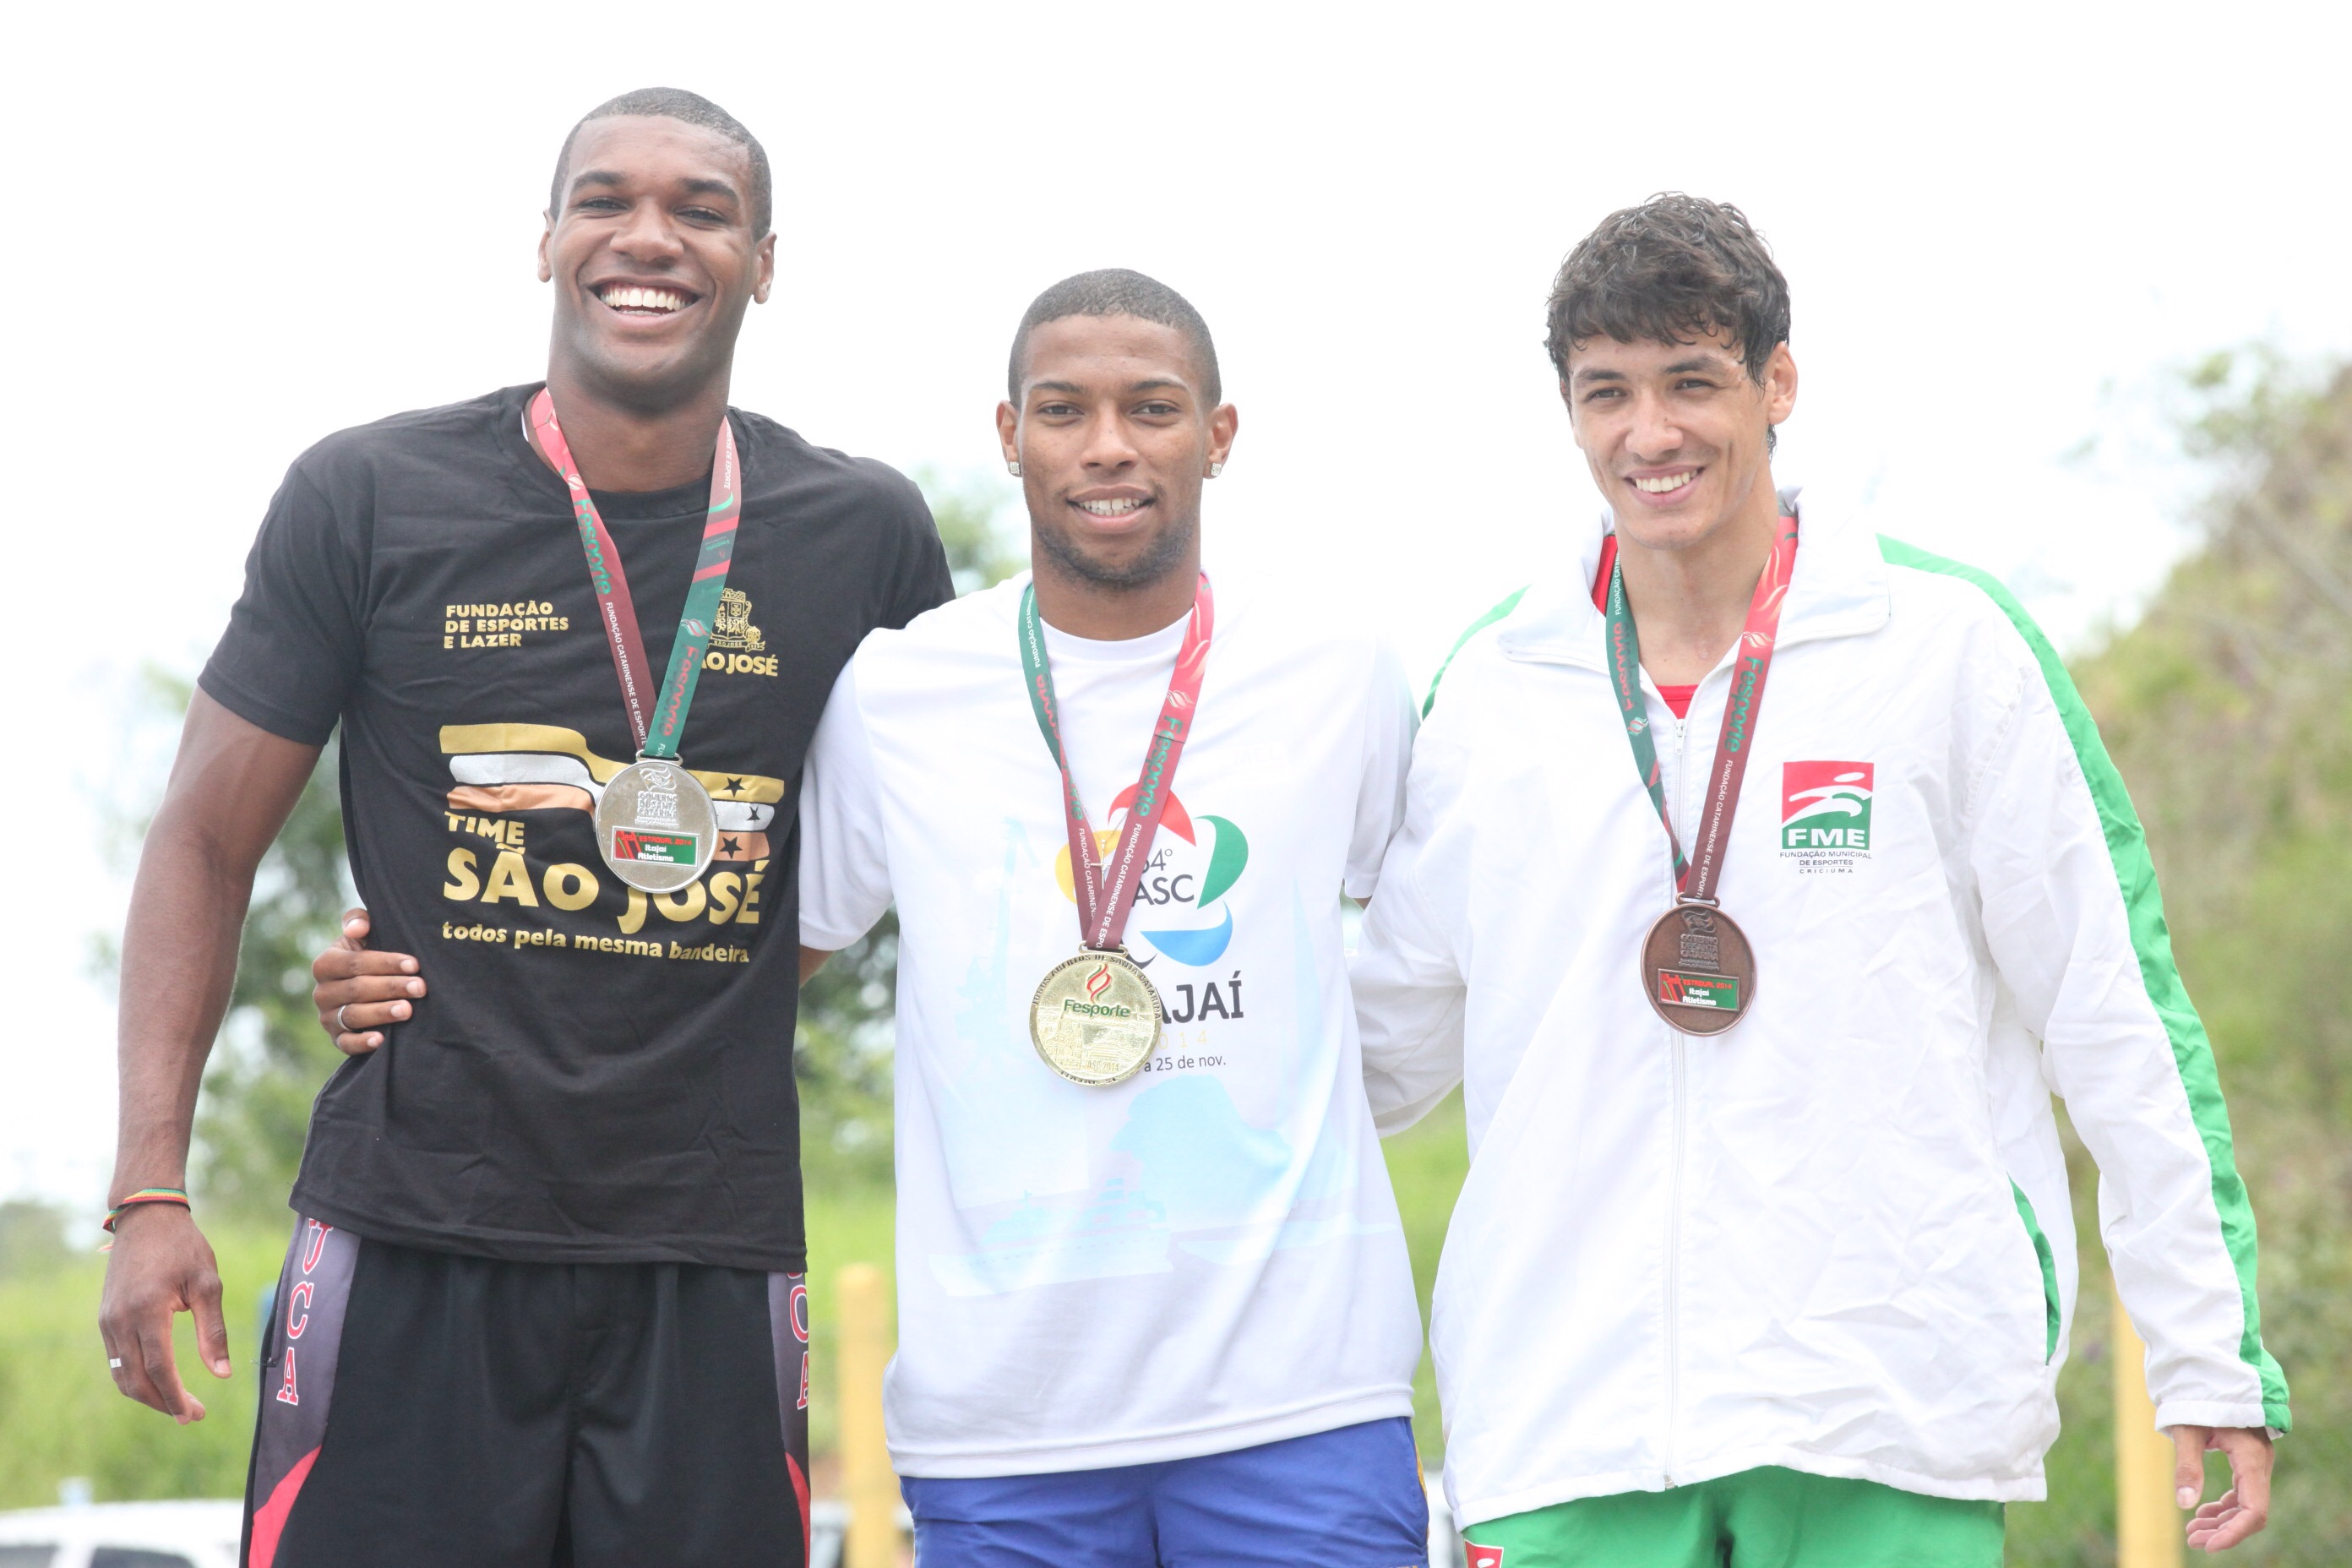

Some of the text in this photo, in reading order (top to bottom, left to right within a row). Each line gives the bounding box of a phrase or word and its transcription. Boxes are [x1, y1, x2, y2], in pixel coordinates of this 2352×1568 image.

[723, 460, 732, 490] ESPORTE
[446, 601, 553, 618] FUNDAÇÃO
[445, 618, 569, 633] DE ESPORTES
[444, 634, 522, 649] E LAZER
[606, 602, 647, 745] FUNDAÇÃO CATARINENSE DE ESPORTE
[1724, 656, 1764, 753] Fesporte
[1134, 715, 1184, 817] Fesporte
[1718, 760, 1734, 801] FUNDAÇÃO
[444, 811, 525, 846] TIME
[1706, 802, 1723, 853] CATARINENSE
[1788, 828, 1865, 847] FME
[638, 852, 674, 862] Atletismo
[1079, 828, 1091, 868] FUNDAÇÃO
[1703, 854, 1712, 866] DE
[1780, 850, 1872, 859] FUNDAÇÃO MUNICIPAL
[443, 843, 770, 934] SÃO JOSÉ
[1096, 823, 1142, 949] FUNDAÇÃO CATARINENSE DE ESPO
[1131, 874, 1195, 907] ASC
[442, 921, 749, 963] todos pela mesma bandeira
[1063, 999, 1131, 1018] Fesporte
[1682, 995, 1717, 1006] Atletismo
[1156, 1057, 1173, 1071] 25
[1177, 1055, 1195, 1069] de
[1199, 1055, 1227, 1068] nov.
